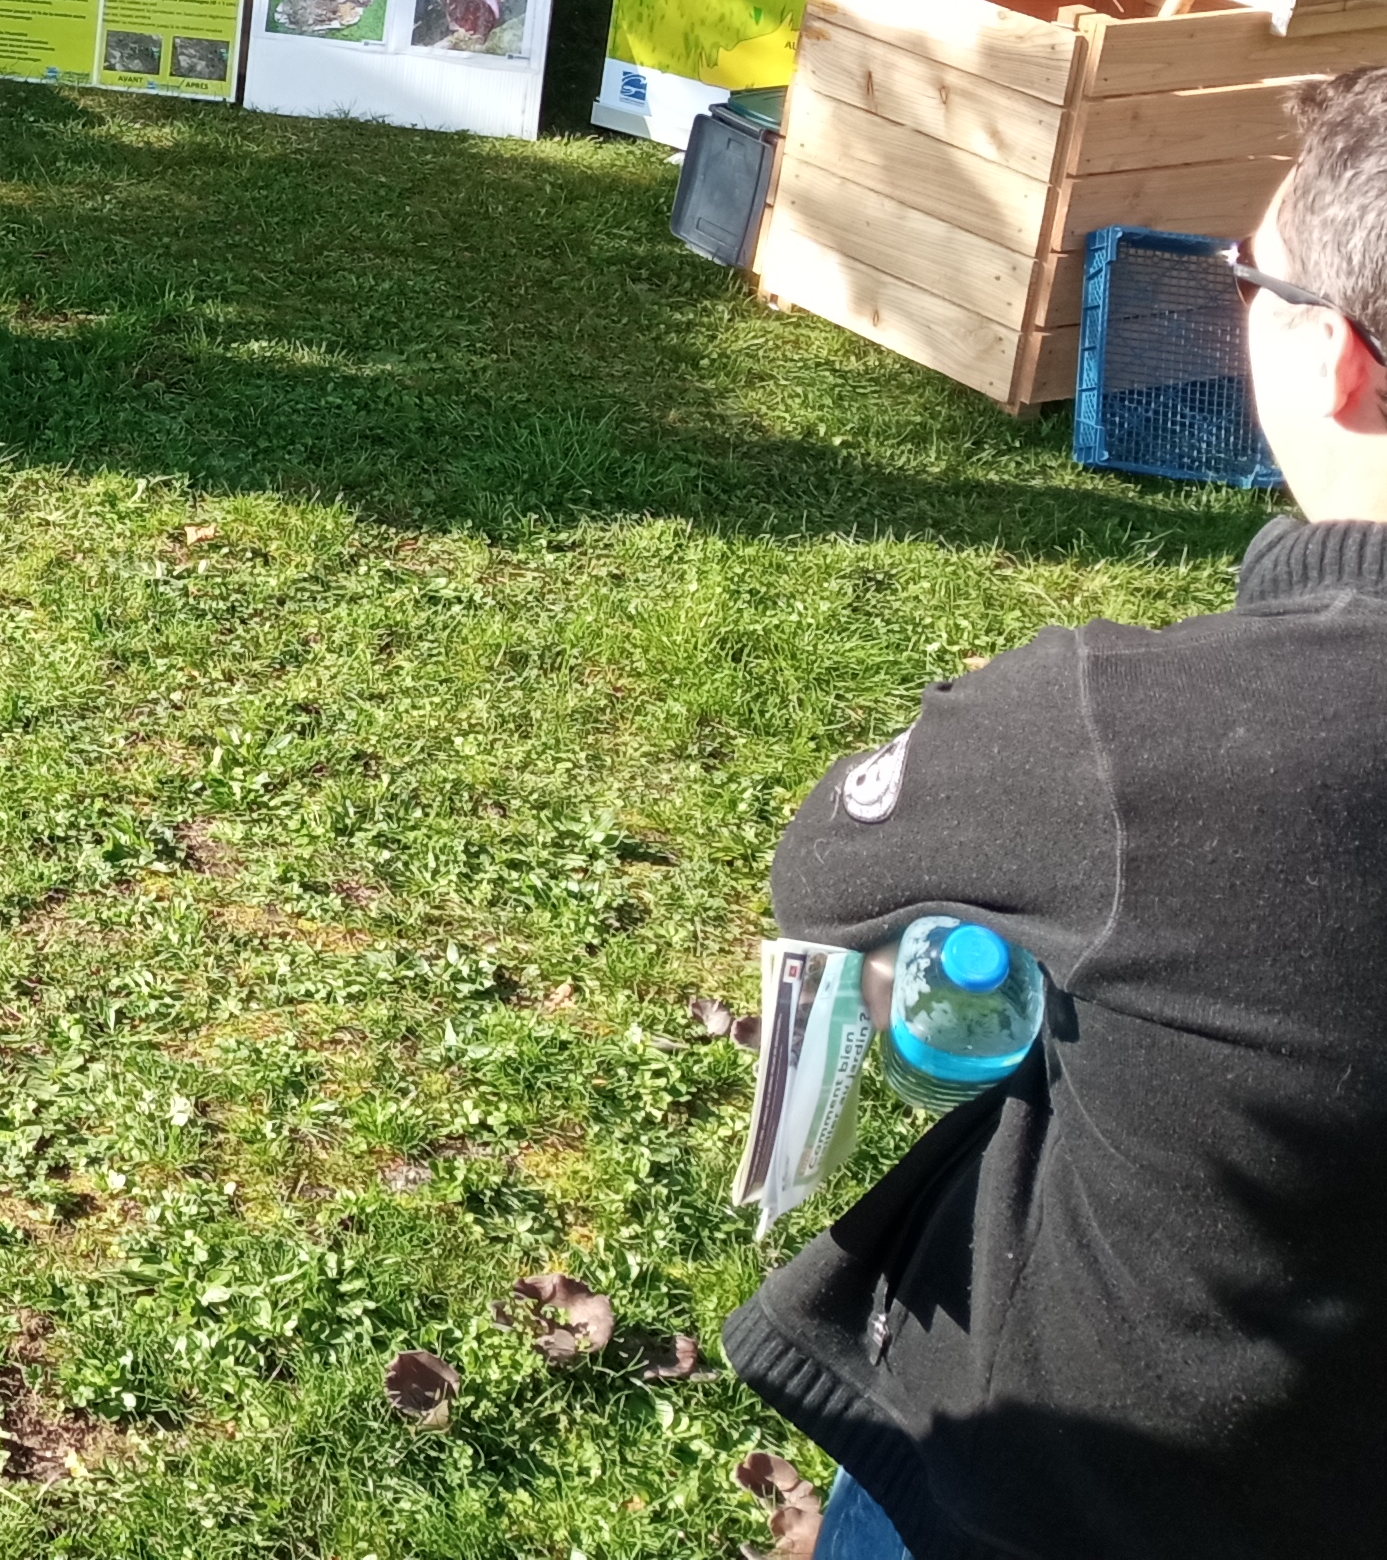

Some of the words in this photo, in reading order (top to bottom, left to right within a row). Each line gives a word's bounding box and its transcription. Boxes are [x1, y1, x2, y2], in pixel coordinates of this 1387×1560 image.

[117, 75, 144, 84] AVANT
[808, 1080, 845, 1170] Comment
[838, 1030, 855, 1073] bien
